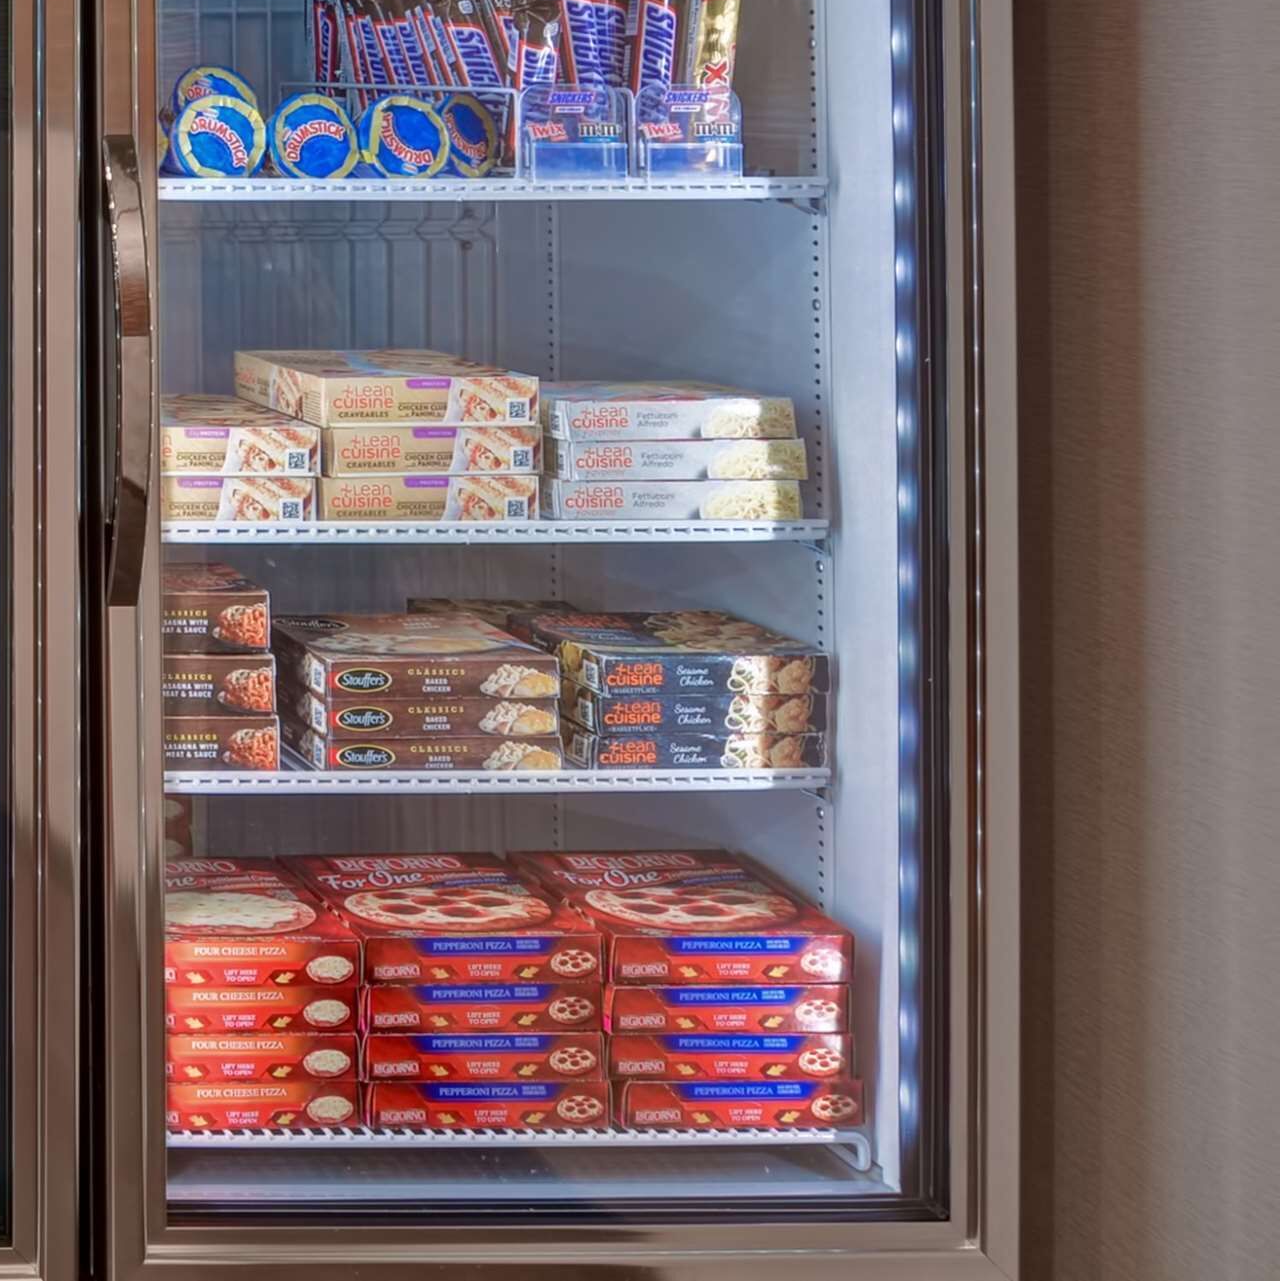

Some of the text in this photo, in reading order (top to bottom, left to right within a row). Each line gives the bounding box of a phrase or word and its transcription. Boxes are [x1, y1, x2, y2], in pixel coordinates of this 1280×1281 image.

[190, 117, 247, 167] DRUMSTICK
[286, 121, 346, 162] DRUMSTICK
[407, 668, 466, 676] CLASSICS
[341, 711, 386, 726] Stouffer's
[678, 715, 711, 725] Chicken
[317, 874, 366, 890] For
[367, 871, 424, 887] One
[603, 869, 664, 887] One
[433, 941, 513, 951] PEPPERONI PIZZA
[682, 940, 762, 950] PEPPERONI PIZZA
[193, 947, 287, 956] FOUR CHEESE PIZZA
